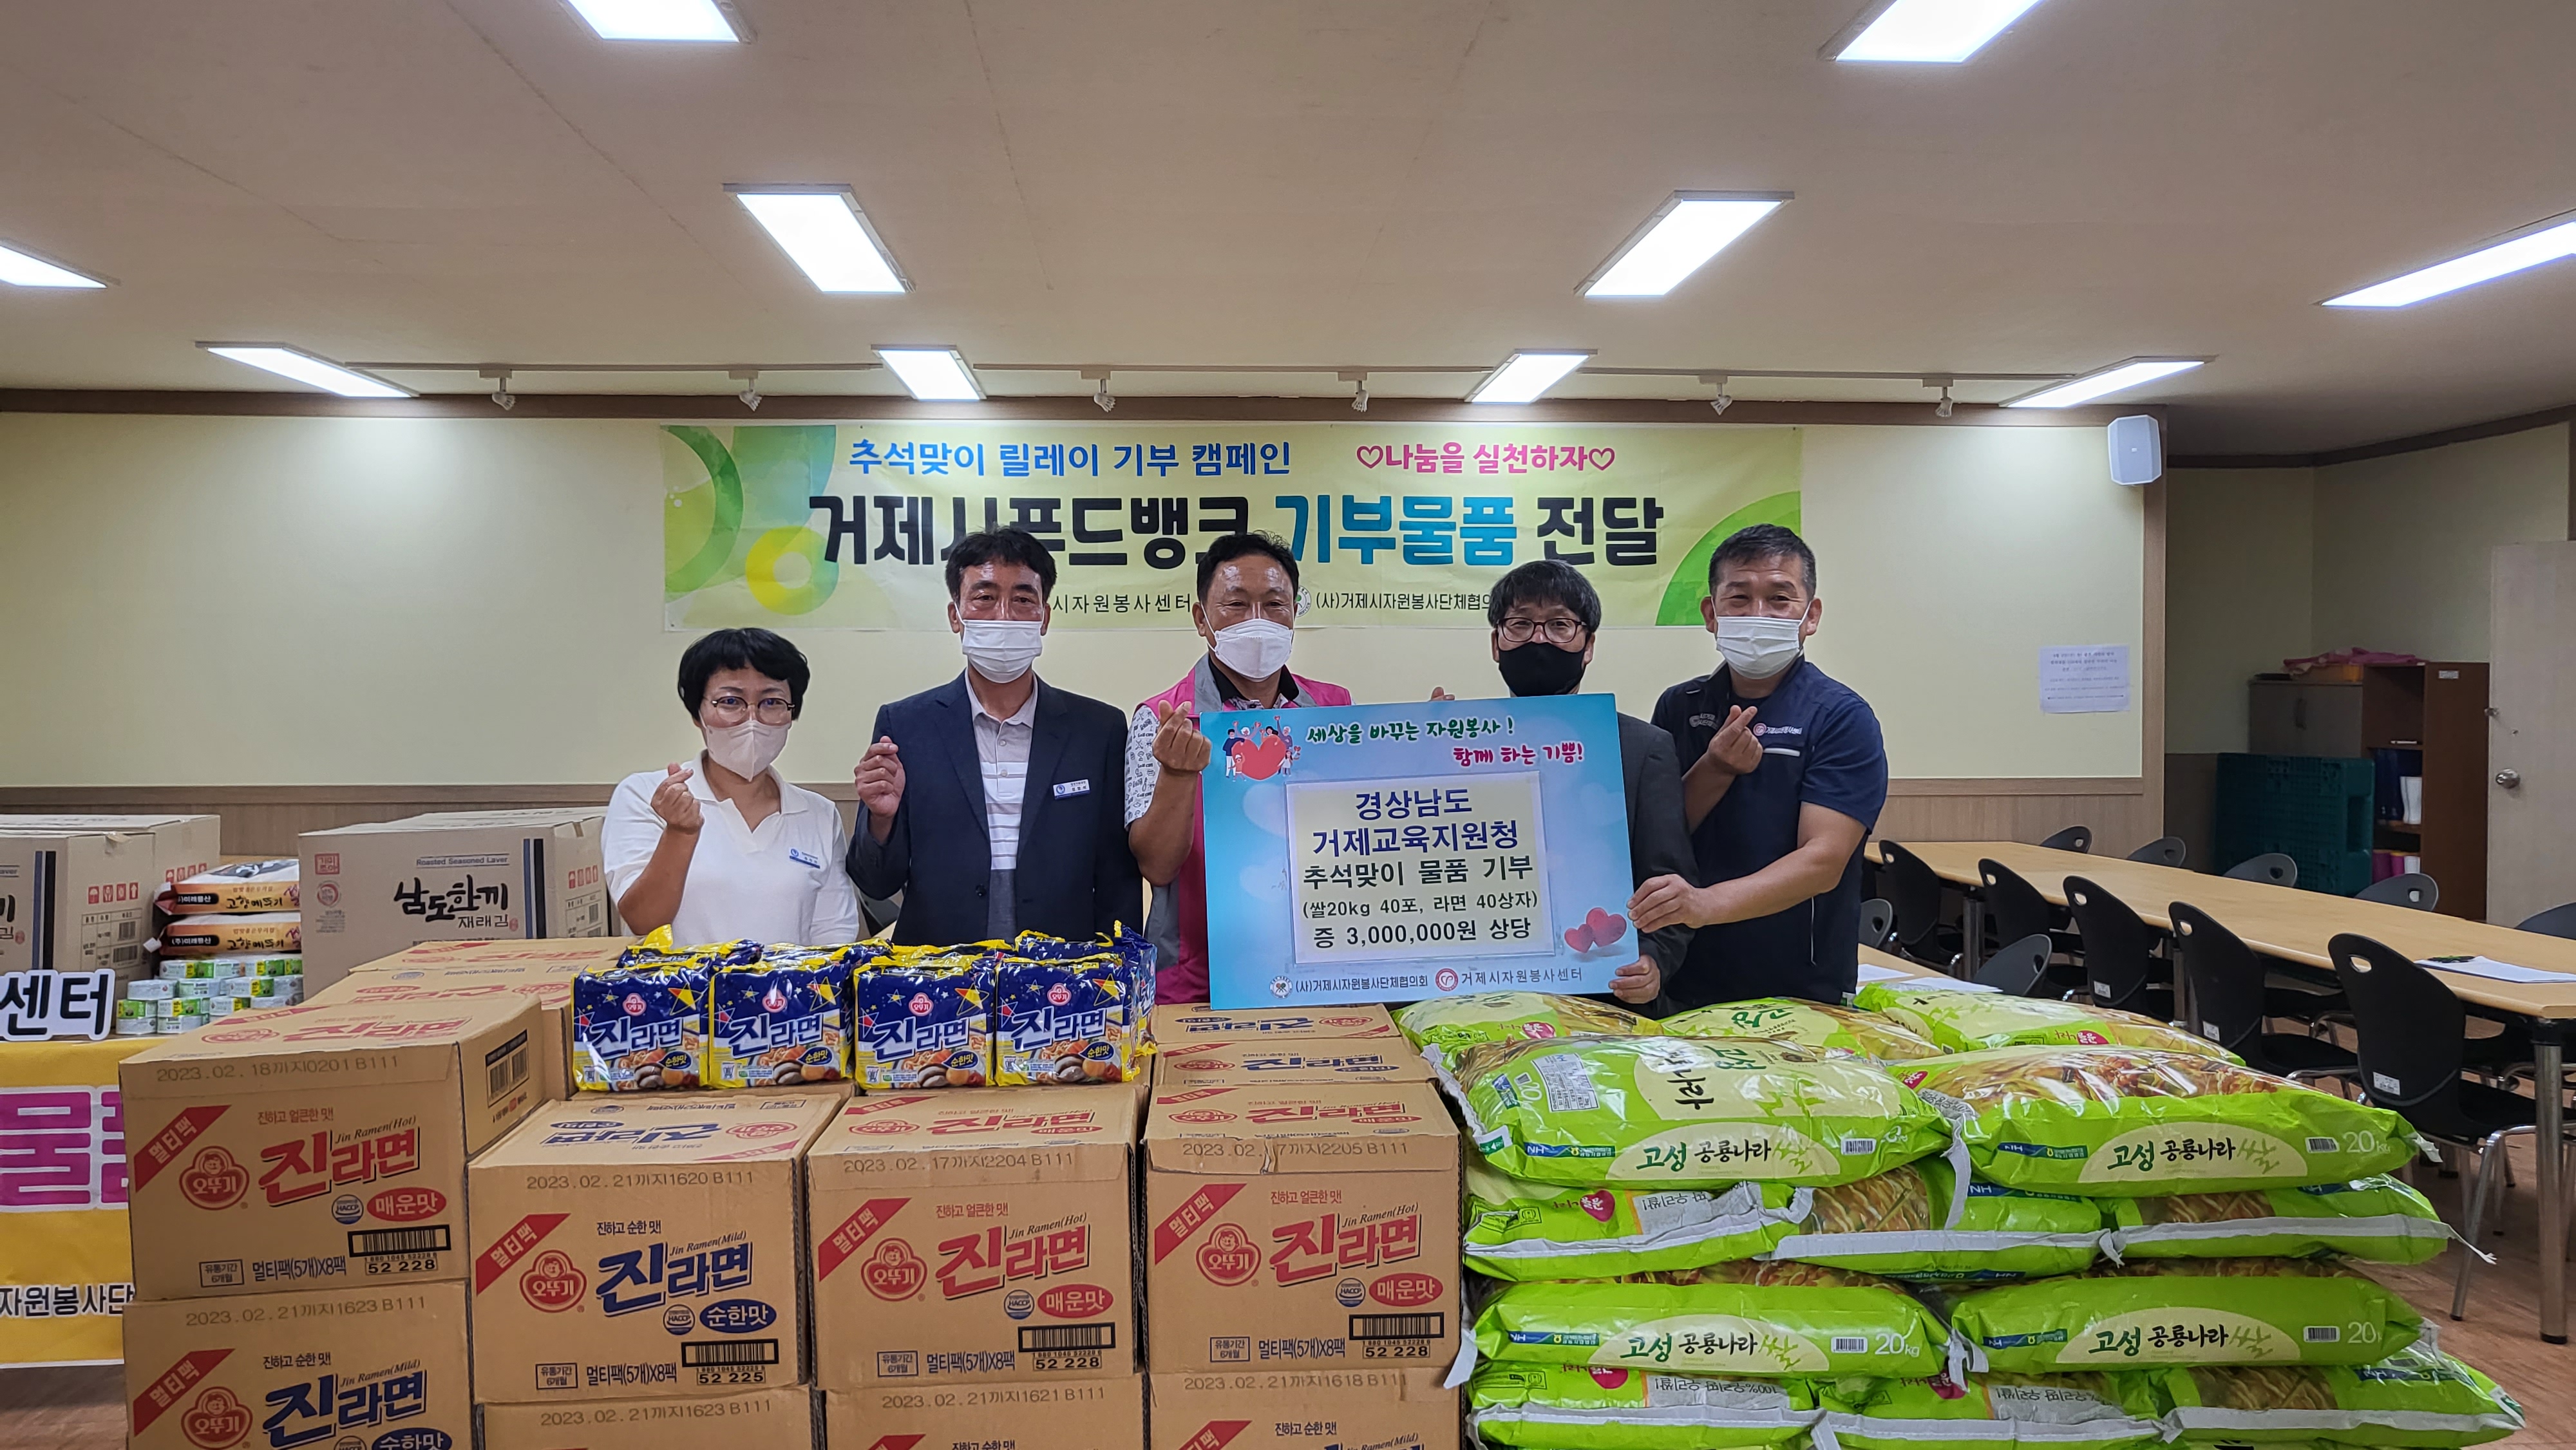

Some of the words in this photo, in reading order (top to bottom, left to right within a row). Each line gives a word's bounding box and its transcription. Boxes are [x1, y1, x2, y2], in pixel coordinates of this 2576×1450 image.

[849, 439, 985, 476] 추석맞이
[999, 443, 1098, 477] 릴레이
[1113, 443, 1179, 476] 기부
[1192, 442, 1290, 476] 캠페인
[1385, 442, 1464, 473] 나눔을
[1473, 444, 1587, 474] 실천하자
[1275, 494, 1518, 566] 기부물품
[1537, 496, 1664, 566] 전달
[1307, 722, 1365, 744] 세상을
[1370, 721, 1421, 740] 바꾸는
[1426, 718, 1501, 739] 자원봉사
[1453, 747, 1493, 765] 함께
[1501, 746, 1537, 763] 하는
[1543, 742, 1584, 762] 기쁨!
[1355, 787, 1472, 820] 경상남도
[1312, 820, 1518, 857] 거제교육지원청
[448, 857, 484, 865] Seasoned
[486, 856, 508, 864] Laver
[1303, 862, 1403, 889] 추석맞이
[1417, 858, 1468, 885] 물품
[1482, 856, 1533, 881] 기부
[393, 874, 508, 923] 남도한끼
[1303, 900, 1370, 919] (쌀20kg
[1379, 897, 1425, 915] 40포,
[1434, 894, 1467, 912] 라면
[1475, 890, 1538, 910] 40상자)
[458, 914, 509, 928] 재래김
[1314, 927, 1334, 948] 증
[1347, 919, 1476, 945] 3,000,000원
[1489, 918, 1531, 939] 상당
[1461, 967, 1582, 986] 거제시자원봉사센터
[0, 972, 106, 1037] 센터
[588, 1015, 684, 1060] 진라면
[729, 1013, 824, 1059] 진라면
[872, 1016, 971, 1062] 진라면
[1010, 1006, 1107, 1053] 진라면
[665, 1056, 687, 1068] 순한맛
[804, 1049, 828, 1064] 순한맛
[951, 1053, 974, 1068] 순한맛
[1086, 1044, 1110, 1059] 순한맛
[926, 1112, 1095, 1136] 진라면
[1245, 1102, 1406, 1124] 진라면
[148, 1116, 197, 1164] 멀티팩
[336, 1131, 351, 1144] Jin
[354, 1115, 416, 1141] Ramen(Hot)
[1526, 1145, 1546, 1154] NH
[1636, 1142, 1687, 1172] 고성
[1694, 1138, 1771, 1162] 공룡나라
[2107, 1140, 2155, 1171] 고성
[2160, 1137, 2236, 1162] 공룡나라
[258, 1127, 421, 1207] 진라면
[193, 1176, 238, 1196] 오뚜기
[1969, 1185, 1992, 1193] NH
[375, 1194, 438, 1216] 매운맛
[1168, 1192, 1215, 1239] 멀티팩
[1342, 1218, 1357, 1228] Jin
[1360, 1201, 1419, 1223] Ramen(Hot)
[833, 1207, 880, 1254] 멀티팩
[1009, 1228, 1025, 1239] Jin
[1027, 1212, 1087, 1236] Ramen(Hot)
[490, 1223, 538, 1269] 멀티팩
[670, 1246, 684, 1256] Jin
[687, 1230, 747, 1252] Ramen(Mild)
[1269, 1212, 1422, 1288] 진라면
[368, 1261, 390, 1274] 52
[399, 1259, 435, 1272] 228
[935, 1223, 1091, 1301] 진라면
[1208, 1253, 1251, 1271] 오뚜기
[532, 1279, 574, 1297] 오뚜기
[595, 1241, 753, 1317] 진라면
[873, 1269, 916, 1286] 오뚜기
[1376, 1279, 1436, 1301] 매운맛
[706, 1304, 768, 1326] 순한맛
[1045, 1291, 1105, 1313] 매운맛
[1365, 1347, 1387, 1357] 52
[1394, 1346, 1428, 1357] 228
[1620, 1332, 1672, 1362] 고성
[1678, 1332, 1757, 1356] 공룡나라
[1875, 1333, 1920, 1357] 20kg
[2088, 1326, 2141, 1356] 고성
[2148, 1324, 2229, 1348] 공룡나라
[341, 1375, 355, 1388] Jin
[358, 1359, 421, 1384] Ramen(Mild)
[1035, 1359, 1058, 1370] 52
[1065, 1357, 1100, 1368] 228
[149, 1360, 200, 1408] 멀티팩
[699, 1373, 722, 1384] 52
[728, 1372, 764, 1383] 225
[263, 1370, 427, 1449] 진라면
[194, 1417, 240, 1435] 오뚜기
